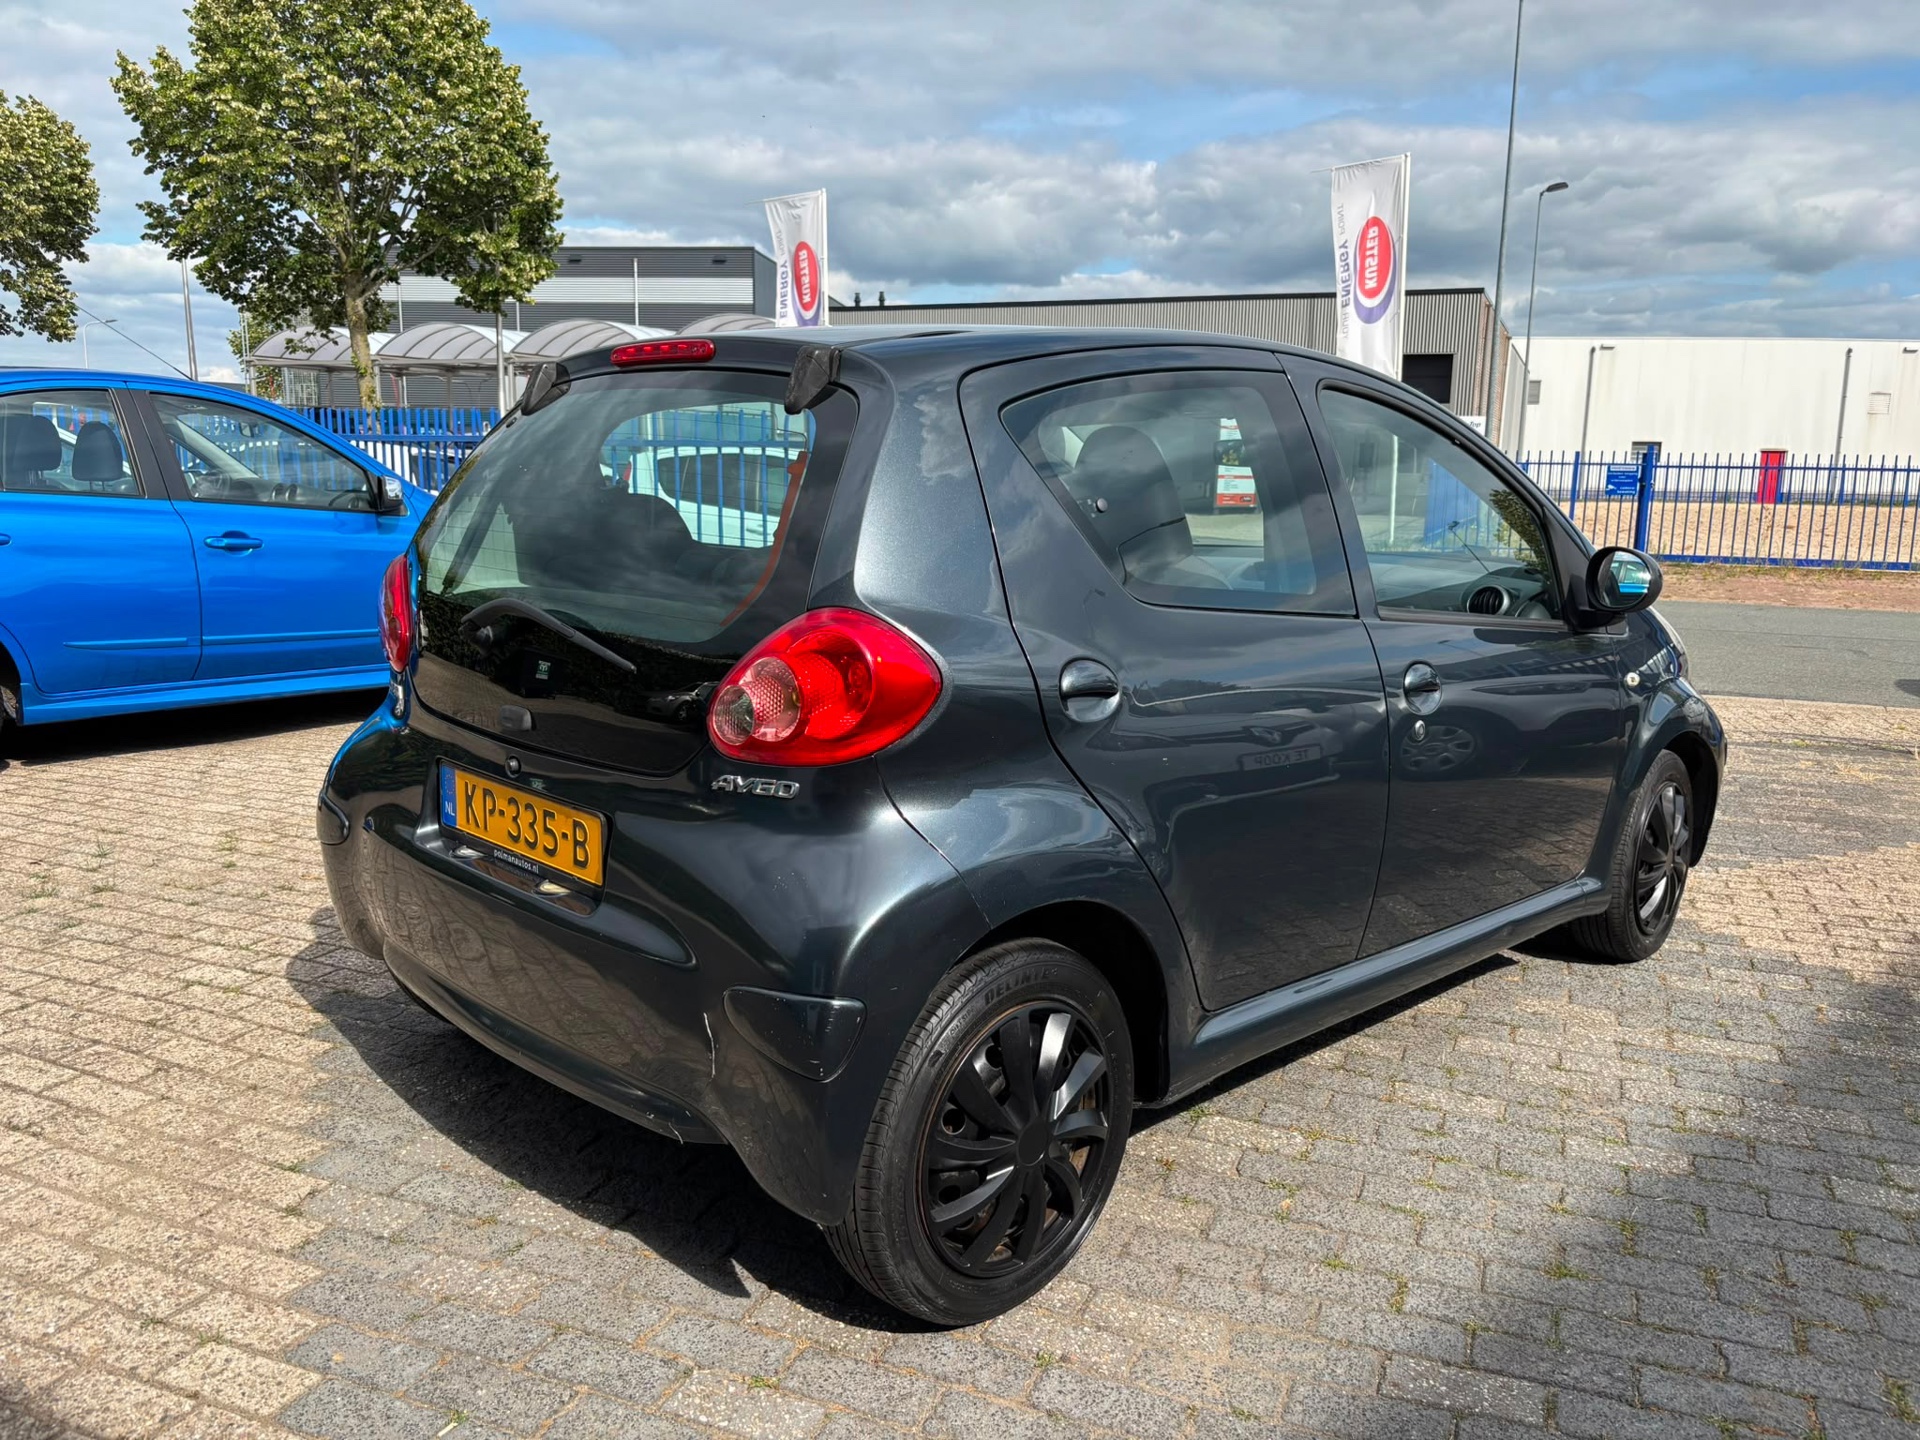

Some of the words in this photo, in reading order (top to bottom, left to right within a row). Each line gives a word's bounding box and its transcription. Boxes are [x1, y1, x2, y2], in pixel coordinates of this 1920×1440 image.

[711, 774, 800, 799] AYGO
[445, 802, 455, 816] NL
[464, 781, 591, 869] KP-335-B
